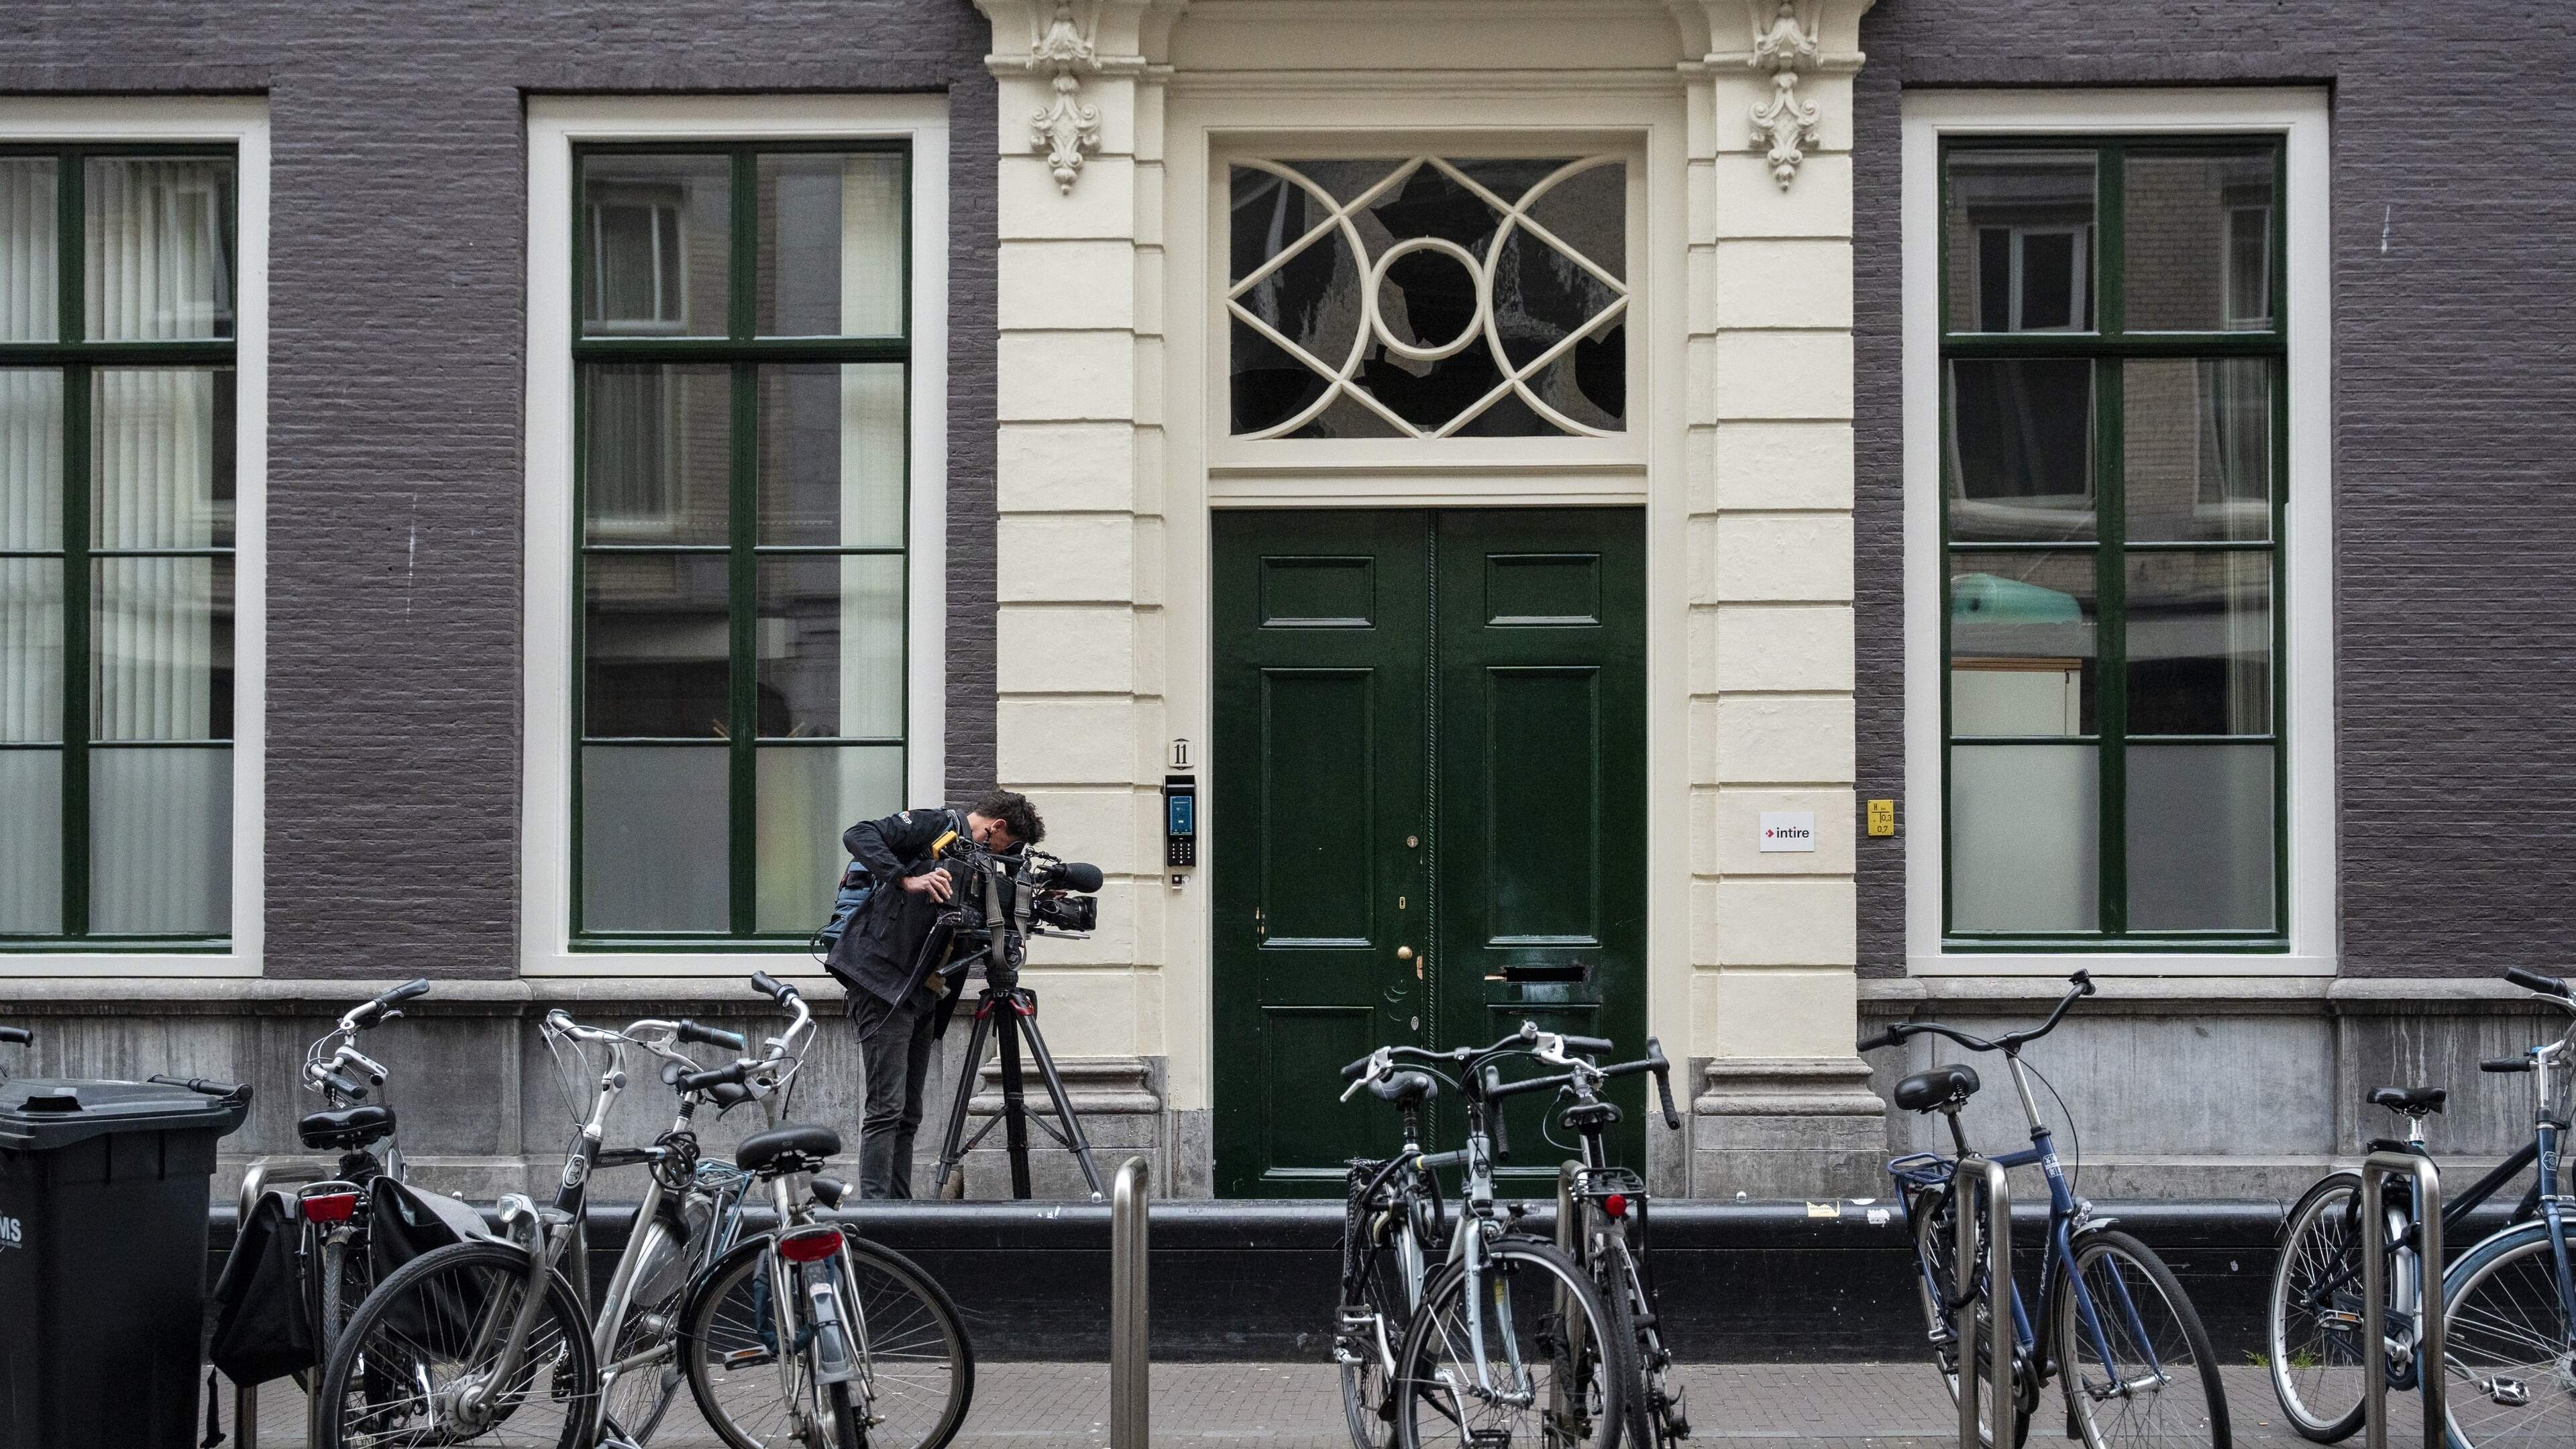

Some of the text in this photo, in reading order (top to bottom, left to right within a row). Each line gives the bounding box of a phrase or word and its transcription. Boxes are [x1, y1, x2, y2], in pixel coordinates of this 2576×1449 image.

[1174, 744, 1187, 764] 11
[902, 814, 912, 824] NEP
[1776, 826, 1809, 838] intire
